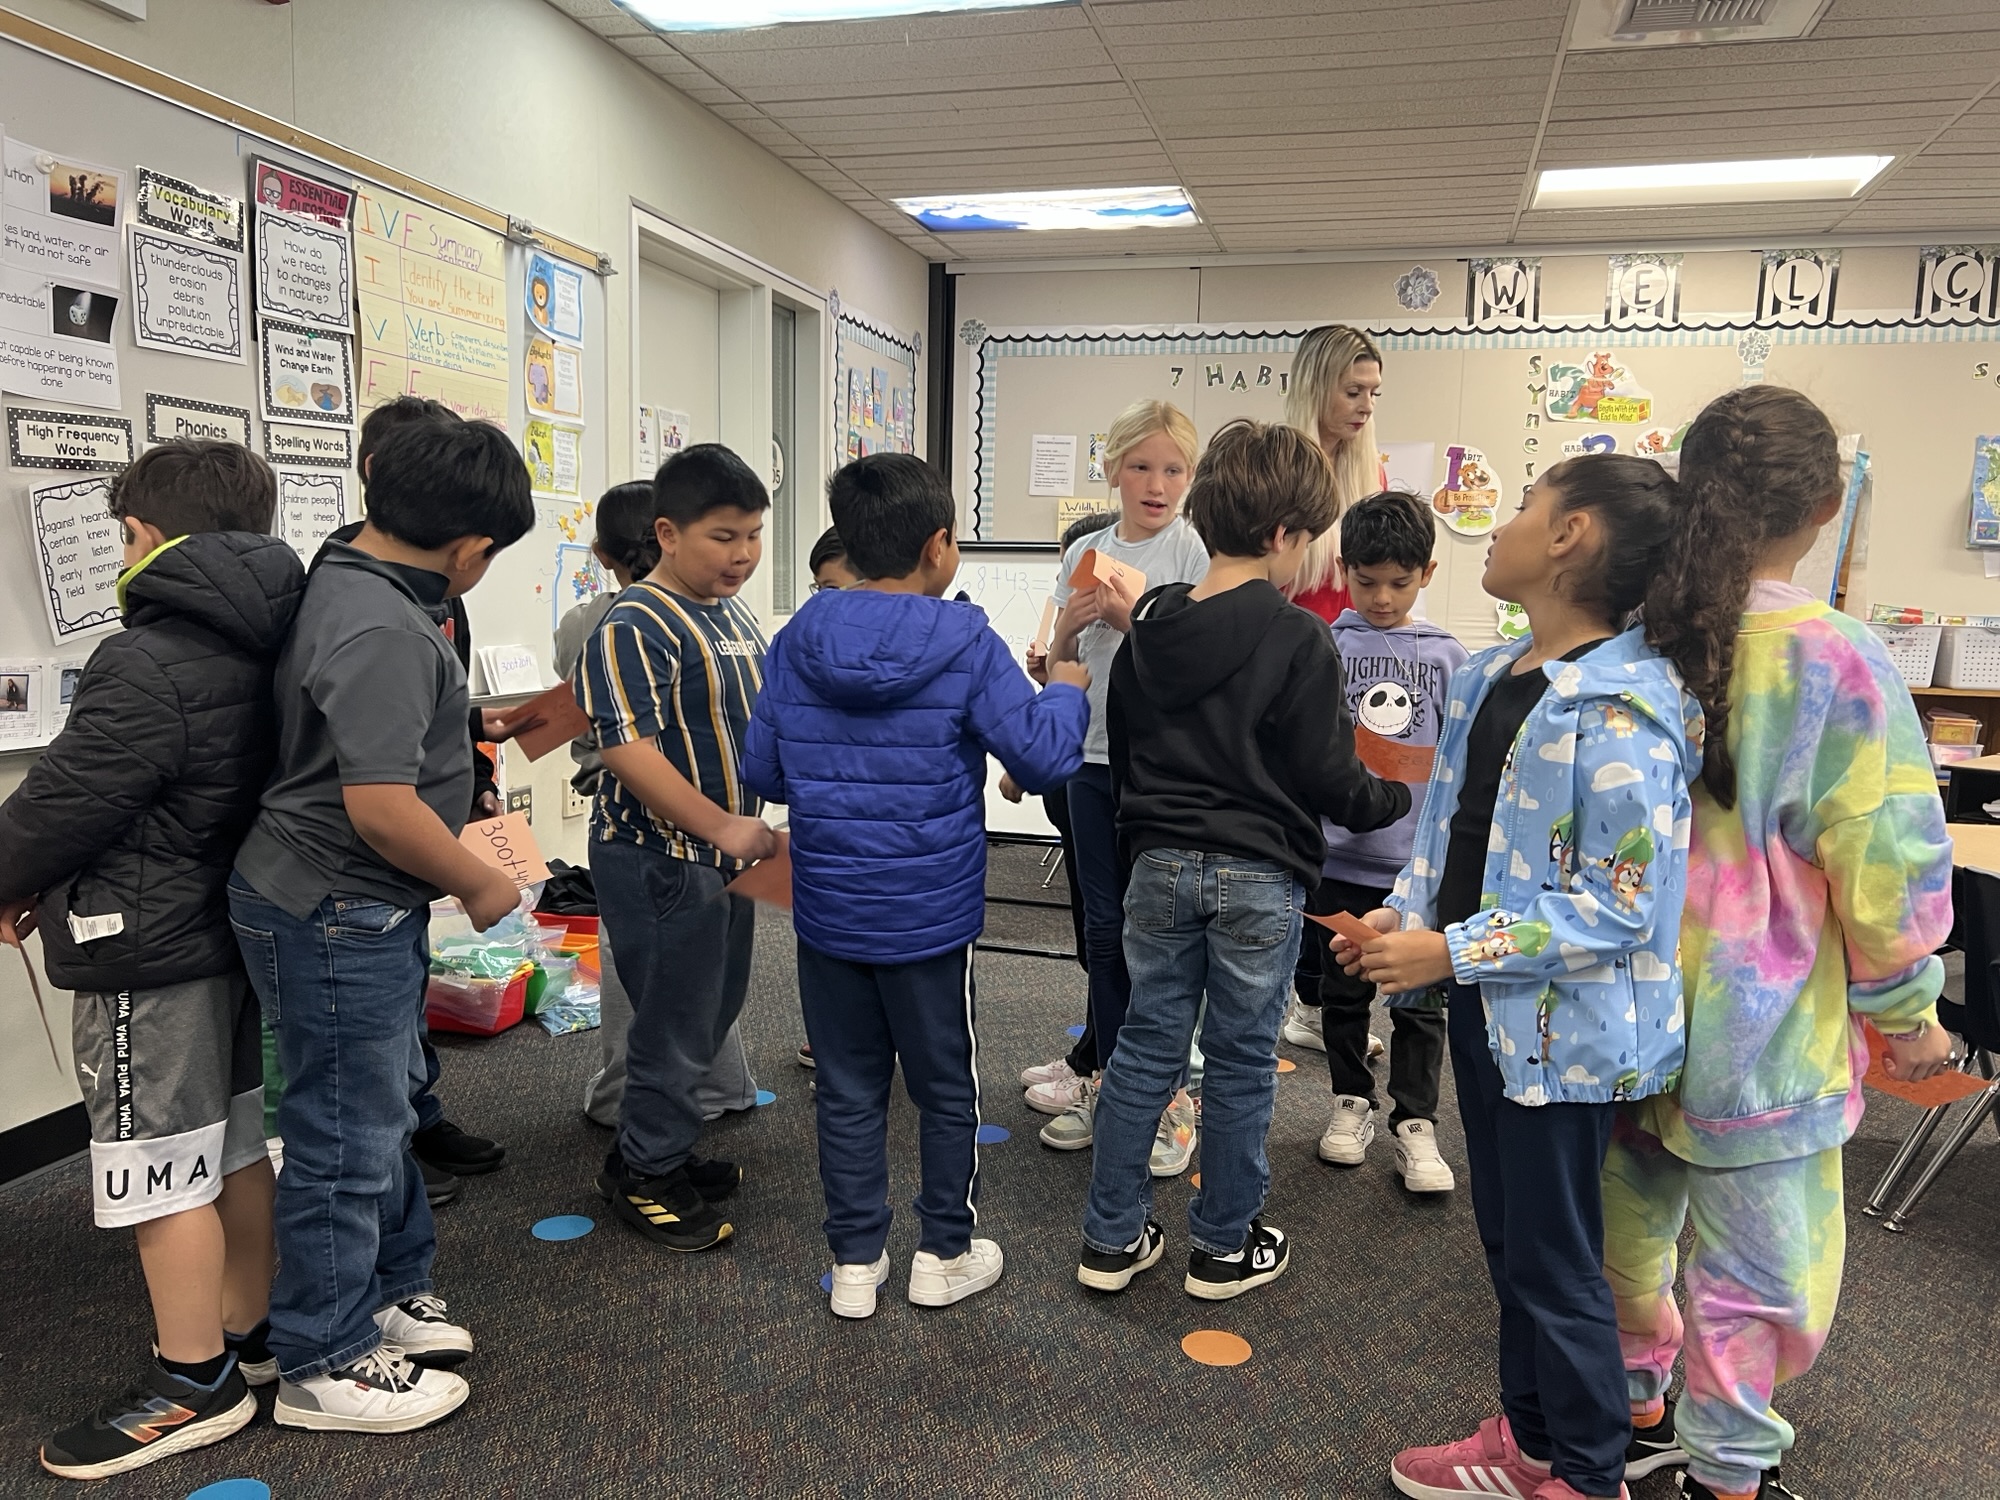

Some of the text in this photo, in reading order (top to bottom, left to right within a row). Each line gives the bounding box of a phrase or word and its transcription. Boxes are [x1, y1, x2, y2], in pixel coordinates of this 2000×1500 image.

[153, 184, 231, 225] Vocabulary
[289, 179, 346, 210] ESSENTIAL
[170, 206, 215, 232] Words
[20, 226, 41, 243] land,
[44, 235, 76, 252] water,
[79, 244, 91, 252] or
[94, 247, 109, 256] air
[283, 239, 323, 260] How do
[429, 224, 484, 272] Summary
[27, 244, 45, 256] and
[47, 249, 64, 260] not
[68, 254, 91, 267] safe
[281, 255, 327, 276] we react
[436, 249, 479, 272] Sentences
[150, 253, 223, 281] thunderclouds
[169, 274, 207, 292] erosion
[277, 269, 332, 292] to changes
[402, 256, 448, 305] Identify
[453, 274, 472, 302] the
[477, 282, 495, 309] text
[173, 289, 205, 306] debris
[279, 284, 330, 305] in nature?
[405, 286, 424, 304] You
[427, 298, 441, 310] are
[168, 303, 211, 322] pollution
[156, 316, 225, 339] unpredictable
[366, 313, 388, 341] V
[9, 343, 42, 357] capable
[44, 349, 56, 359] of
[58, 350, 83, 367] being
[85, 356, 114, 370] known
[274, 343, 336, 363] Wind and Water
[27, 359, 72, 378] happening
[74, 369, 86, 377] or
[88, 370, 112, 385] being
[280, 358, 333, 375] Change Earth
[1171, 367, 1184, 387] 7
[40, 376, 63, 388] done
[1548, 389, 1577, 399] HABIT
[27, 424, 120, 446] High Frequency
[176, 417, 228, 439] Phonics
[55, 443, 97, 457] Words
[274, 434, 345, 452] Spelling Words
[1564, 444, 1592, 453] HABIT
[1456, 453, 1483, 463] HABIT
[311, 496, 336, 508] people
[44, 509, 110, 534] against heard
[290, 511, 336, 524] feet sheep
[49, 528, 110, 550] certain knew
[57, 545, 115, 566] door listen
[60, 568, 83, 583] early
[65, 584, 86, 599] field
[1498, 602, 1524, 613] HABIT
[117, 991, 130, 1019] UMA
[116, 1024, 129, 1058] PUMA
[117, 1063, 132, 1099] PUMA
[119, 1103, 132, 1140] PUMA
[1407, 1122, 1423, 1134] VANS
[106, 1154, 209, 1201] UMA
